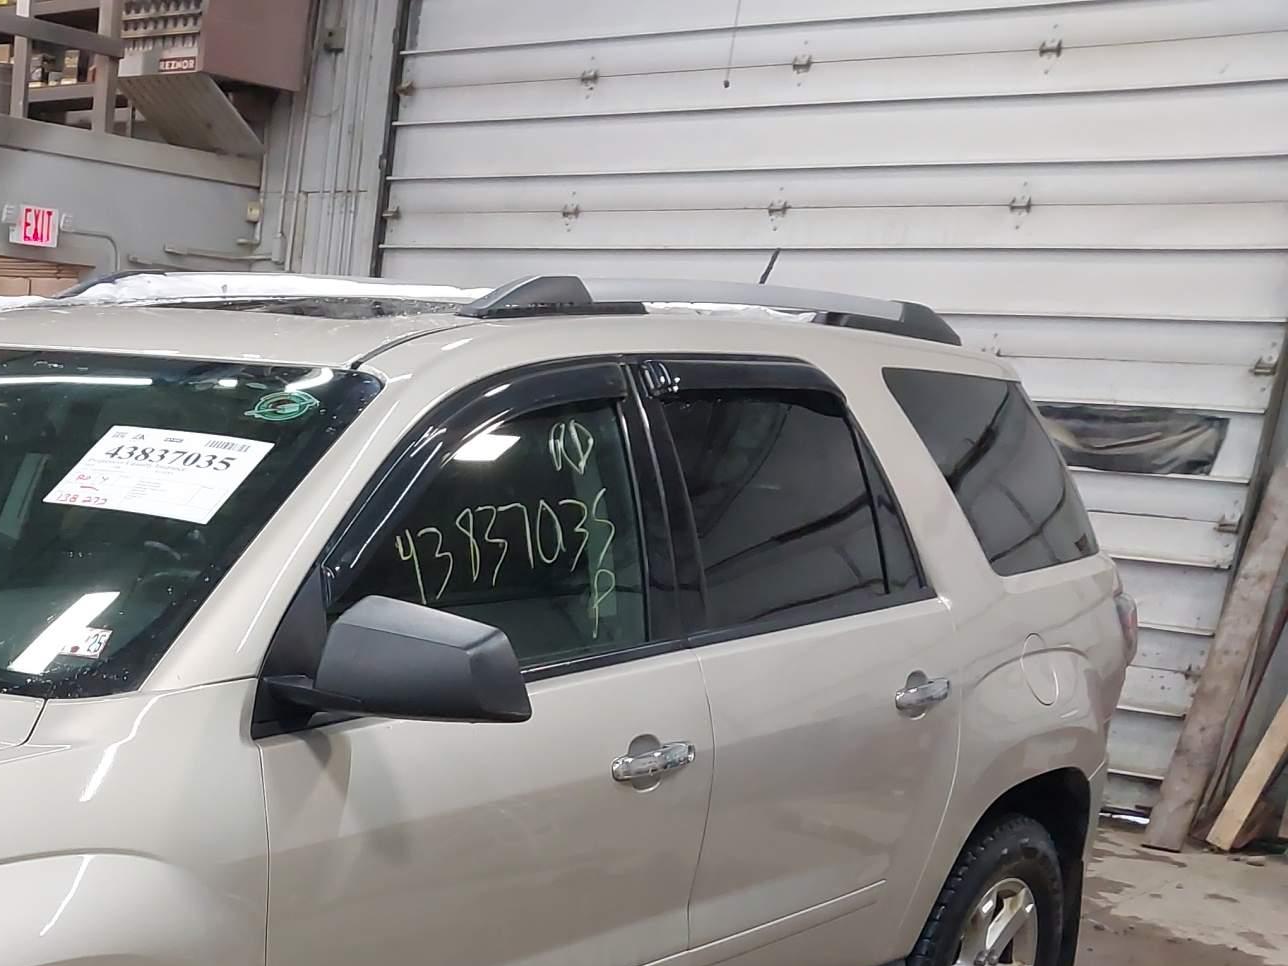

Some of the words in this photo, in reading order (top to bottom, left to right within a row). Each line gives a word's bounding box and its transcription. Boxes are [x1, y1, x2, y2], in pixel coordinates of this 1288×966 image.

[23, 207, 53, 243] EXIT
[105, 445, 237, 472] 43837035
[395, 488, 615, 604] 43837035
